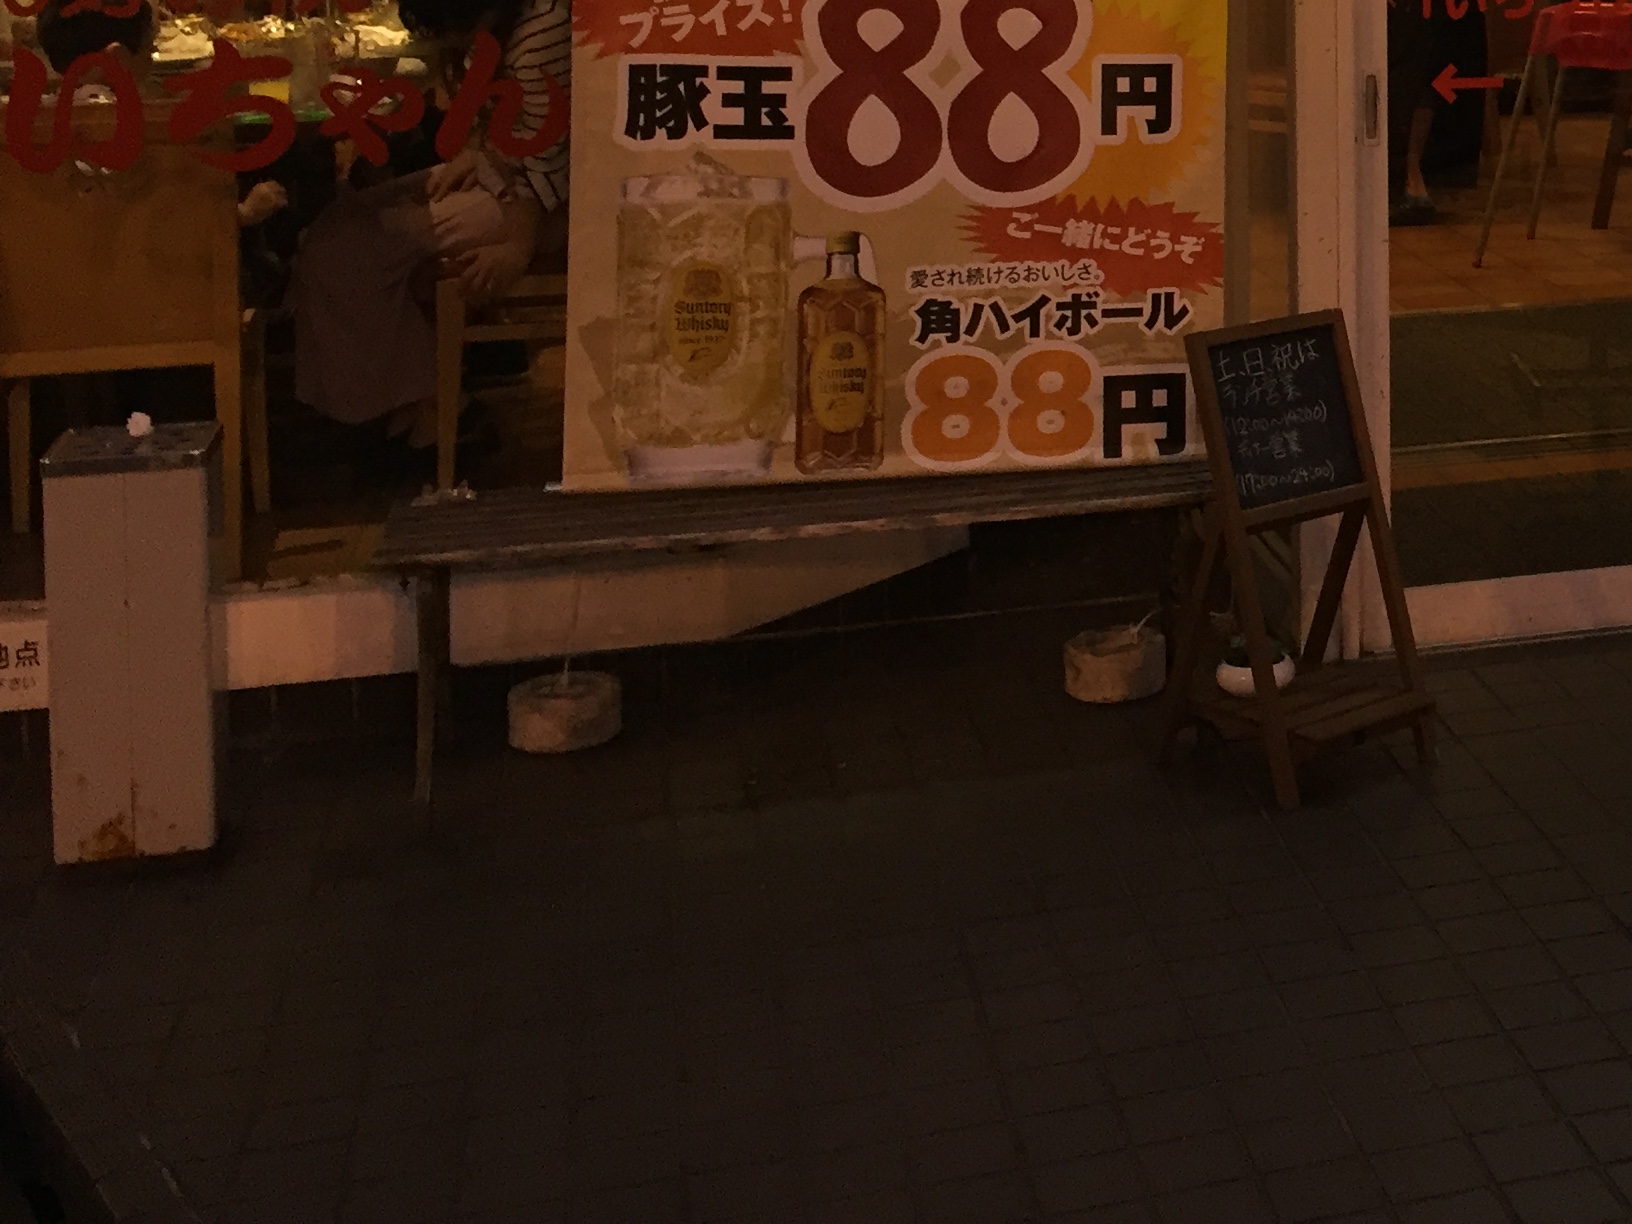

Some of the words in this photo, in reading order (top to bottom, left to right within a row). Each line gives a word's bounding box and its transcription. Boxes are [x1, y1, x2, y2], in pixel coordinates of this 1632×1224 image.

[1006, 211, 1205, 265] ご一緒にどうぞ
[909, 262, 1102, 289] 愛され続けるおいしさ。
[673, 300, 732, 317] Suntory
[674, 316, 730, 333] Whisky
[914, 290, 1191, 345] 角ハイボール
[910, 349, 1187, 463] 88円
